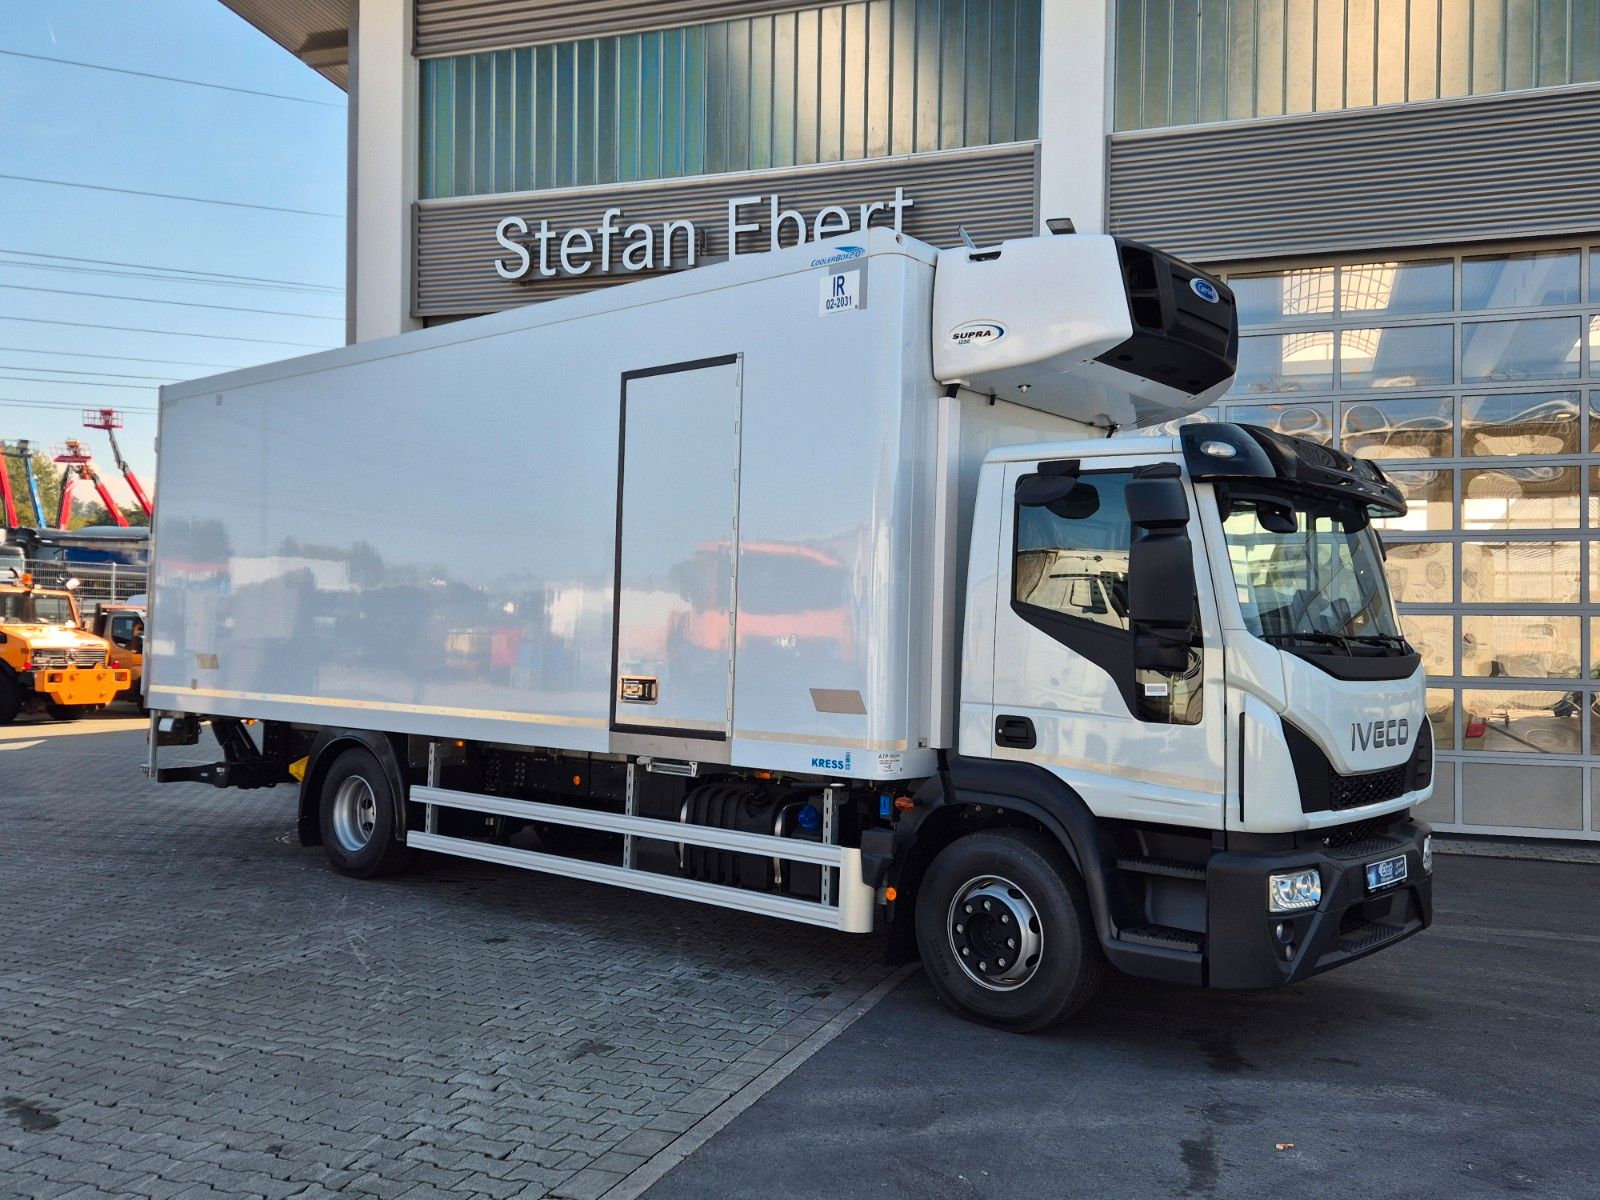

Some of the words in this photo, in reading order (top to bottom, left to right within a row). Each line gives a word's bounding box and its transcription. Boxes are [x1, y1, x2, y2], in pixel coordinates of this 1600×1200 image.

[494, 207, 696, 279] Stefan
[833, 275, 845, 297] IR
[826, 295, 852, 310] 02-2031
[952, 330, 991, 340] SUPRA
[1351, 718, 1409, 752] IVECO
[811, 758, 844, 770] KRESS
